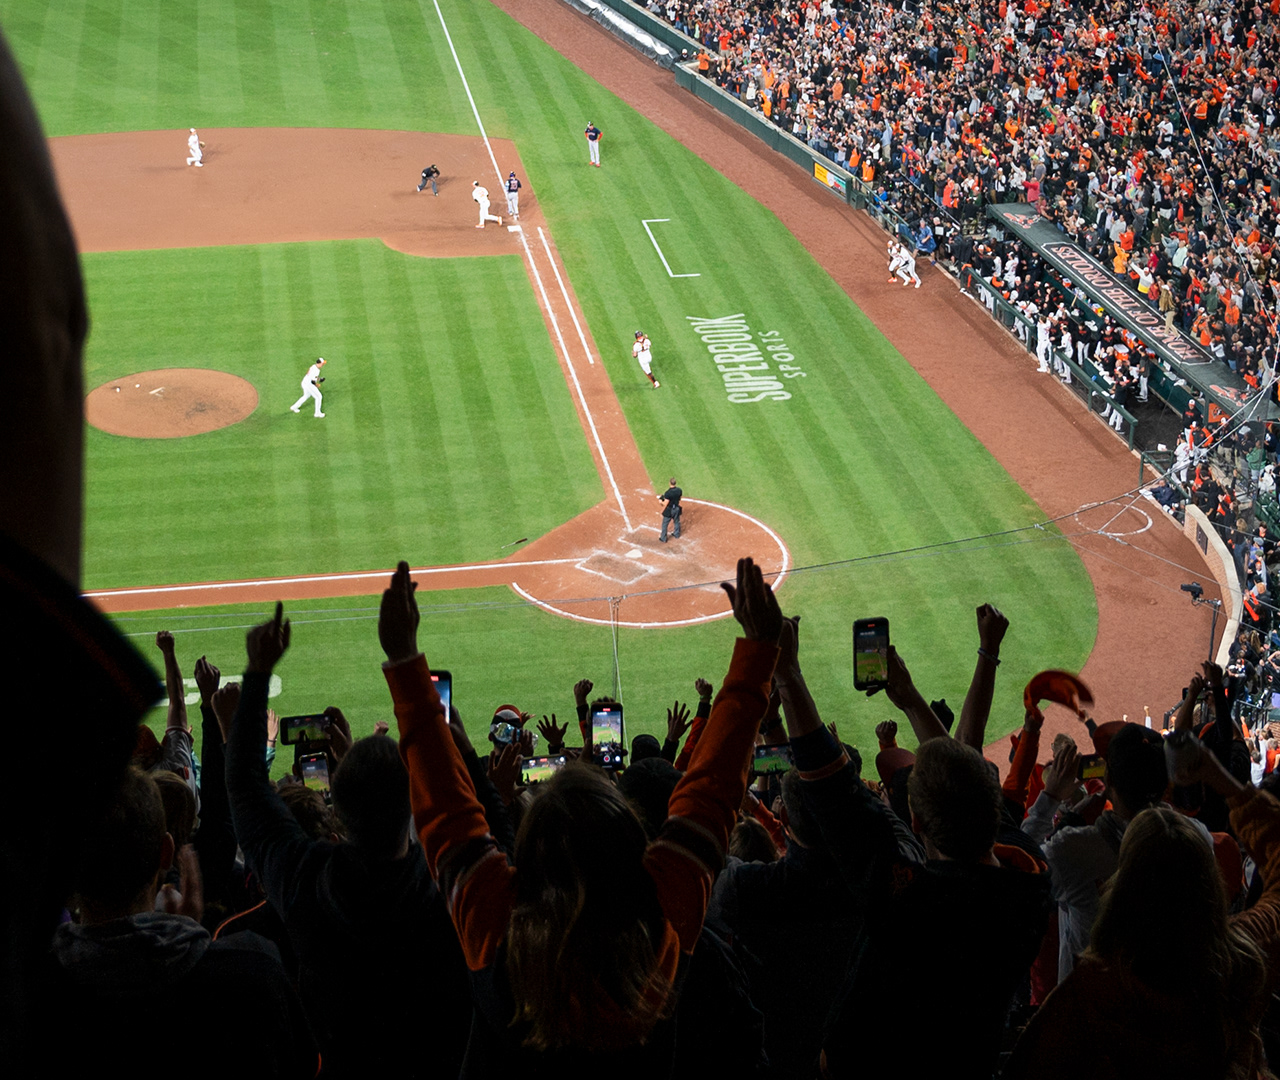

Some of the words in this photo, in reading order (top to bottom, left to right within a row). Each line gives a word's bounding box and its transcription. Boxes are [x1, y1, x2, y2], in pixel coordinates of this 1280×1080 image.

[1053, 246, 1114, 289] ORIOLES
[1108, 284, 1141, 314] THE
[1131, 309, 1159, 326] OF
[686, 313, 792, 403] SUPERBOOK
[758, 330, 807, 378] SPORTS
